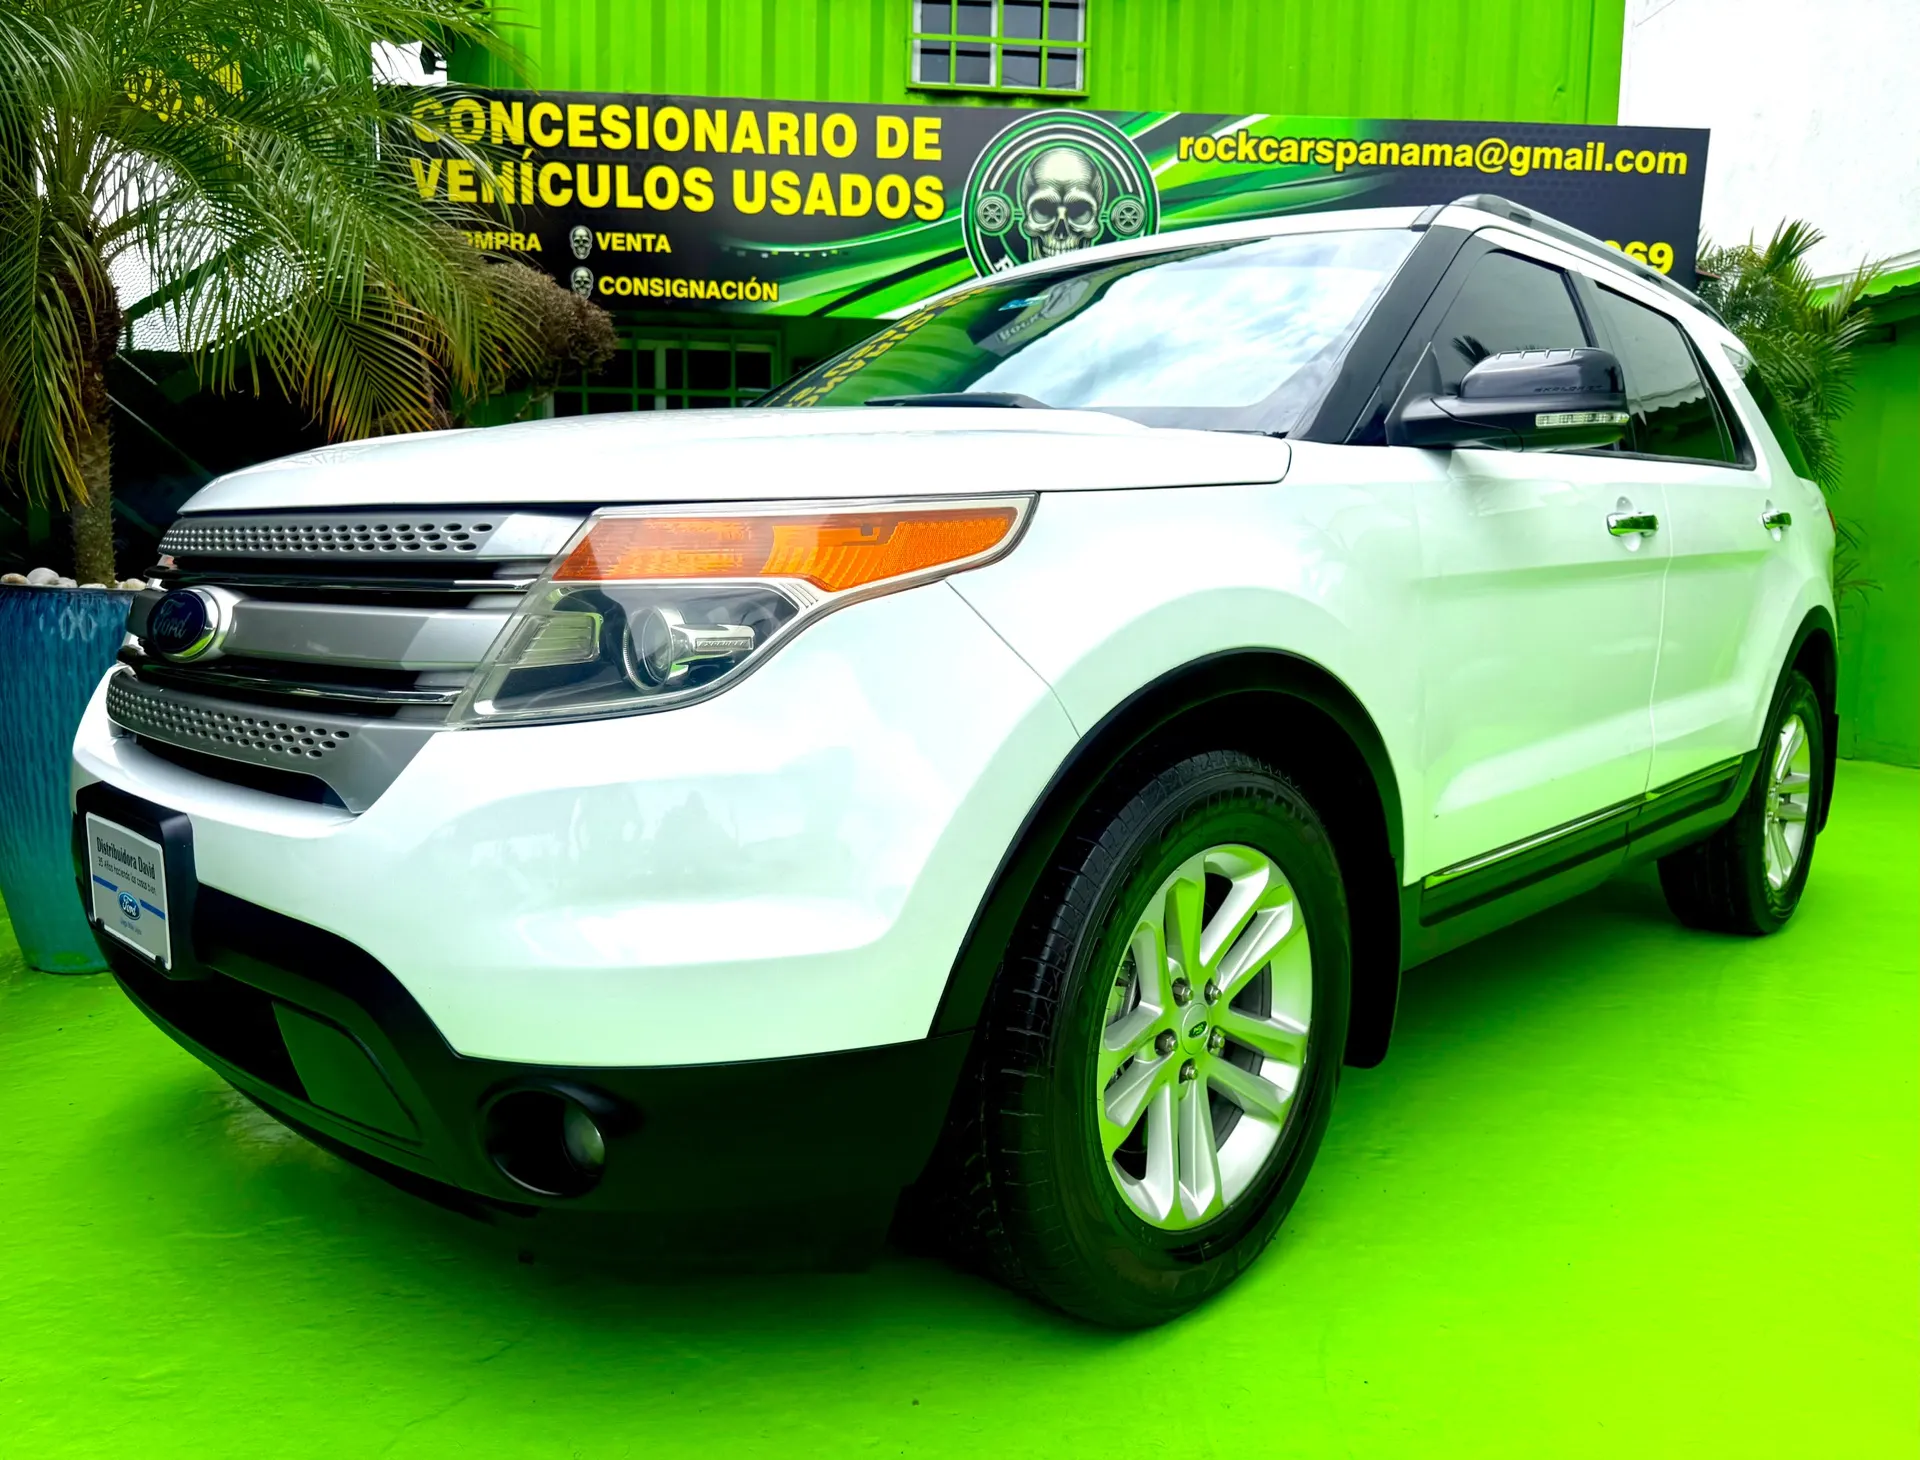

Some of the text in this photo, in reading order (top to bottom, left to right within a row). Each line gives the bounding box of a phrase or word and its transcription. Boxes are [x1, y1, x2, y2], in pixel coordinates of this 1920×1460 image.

[411, 97, 942, 161] CONCESIONARIO DE
[1178, 130, 1687, 177] rockcarspanama@gmail.com
[410, 148, 944, 221] VEHÍCULOS USADOS
[596, 231, 672, 253] VENTA
[598, 276, 778, 302] CONSIGNACIÓN
[153, 599, 192, 640] Ford
[96, 836, 156, 881] Distribuidora David
[122, 894, 137, 917] Ford
